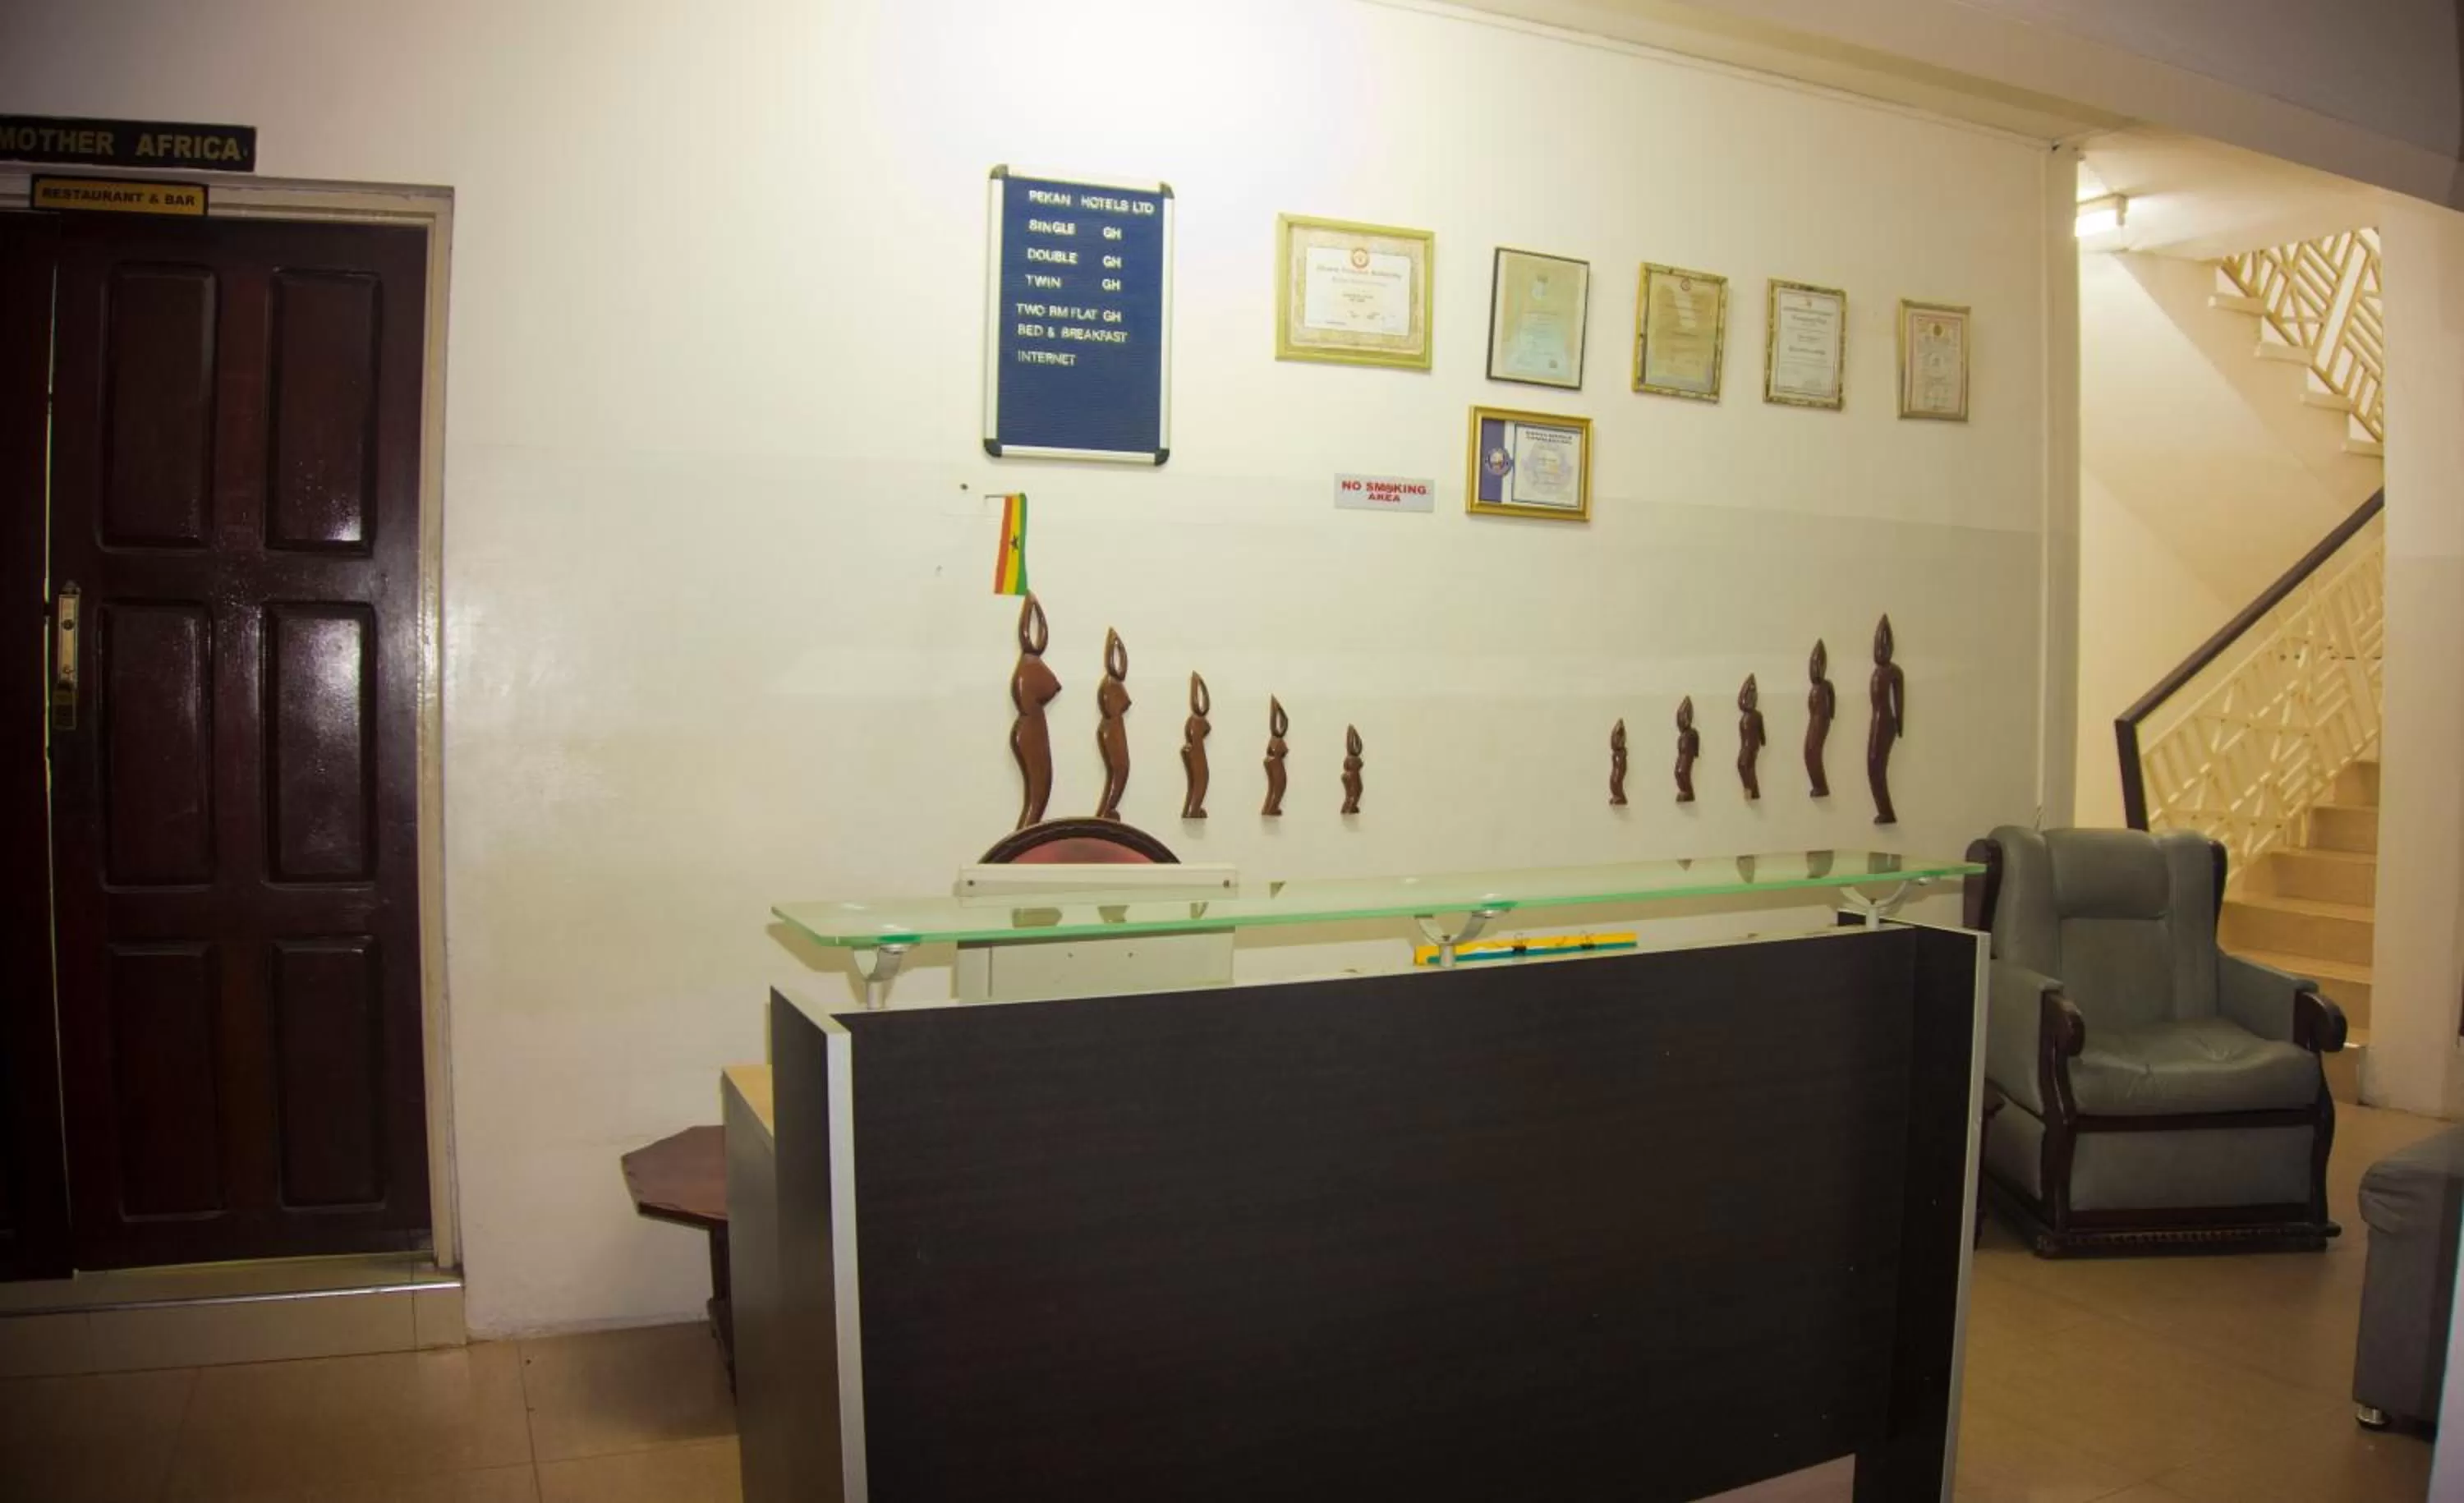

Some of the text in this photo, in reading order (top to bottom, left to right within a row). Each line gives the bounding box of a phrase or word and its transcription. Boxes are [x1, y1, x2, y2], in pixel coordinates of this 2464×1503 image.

[0, 126, 241, 161] MOTHER AFRICA
[41, 186, 195, 206] RESTAURANT & BAR
[1028, 190, 1155, 214] PEKAN HOTELS LTD
[1028, 219, 1122, 240] SINGLE GH
[1027, 248, 1122, 269] DOUBLE GH
[1026, 274, 1121, 291] TWIN GH
[1017, 303, 1121, 322] TWO RM FLAT GH
[1018, 324, 1128, 342] BED & BREAKFAST
[1018, 350, 1075, 365] INTERNET
[1341, 480, 1427, 494] NO SMOKING
[1368, 494, 1400, 503] AREA
